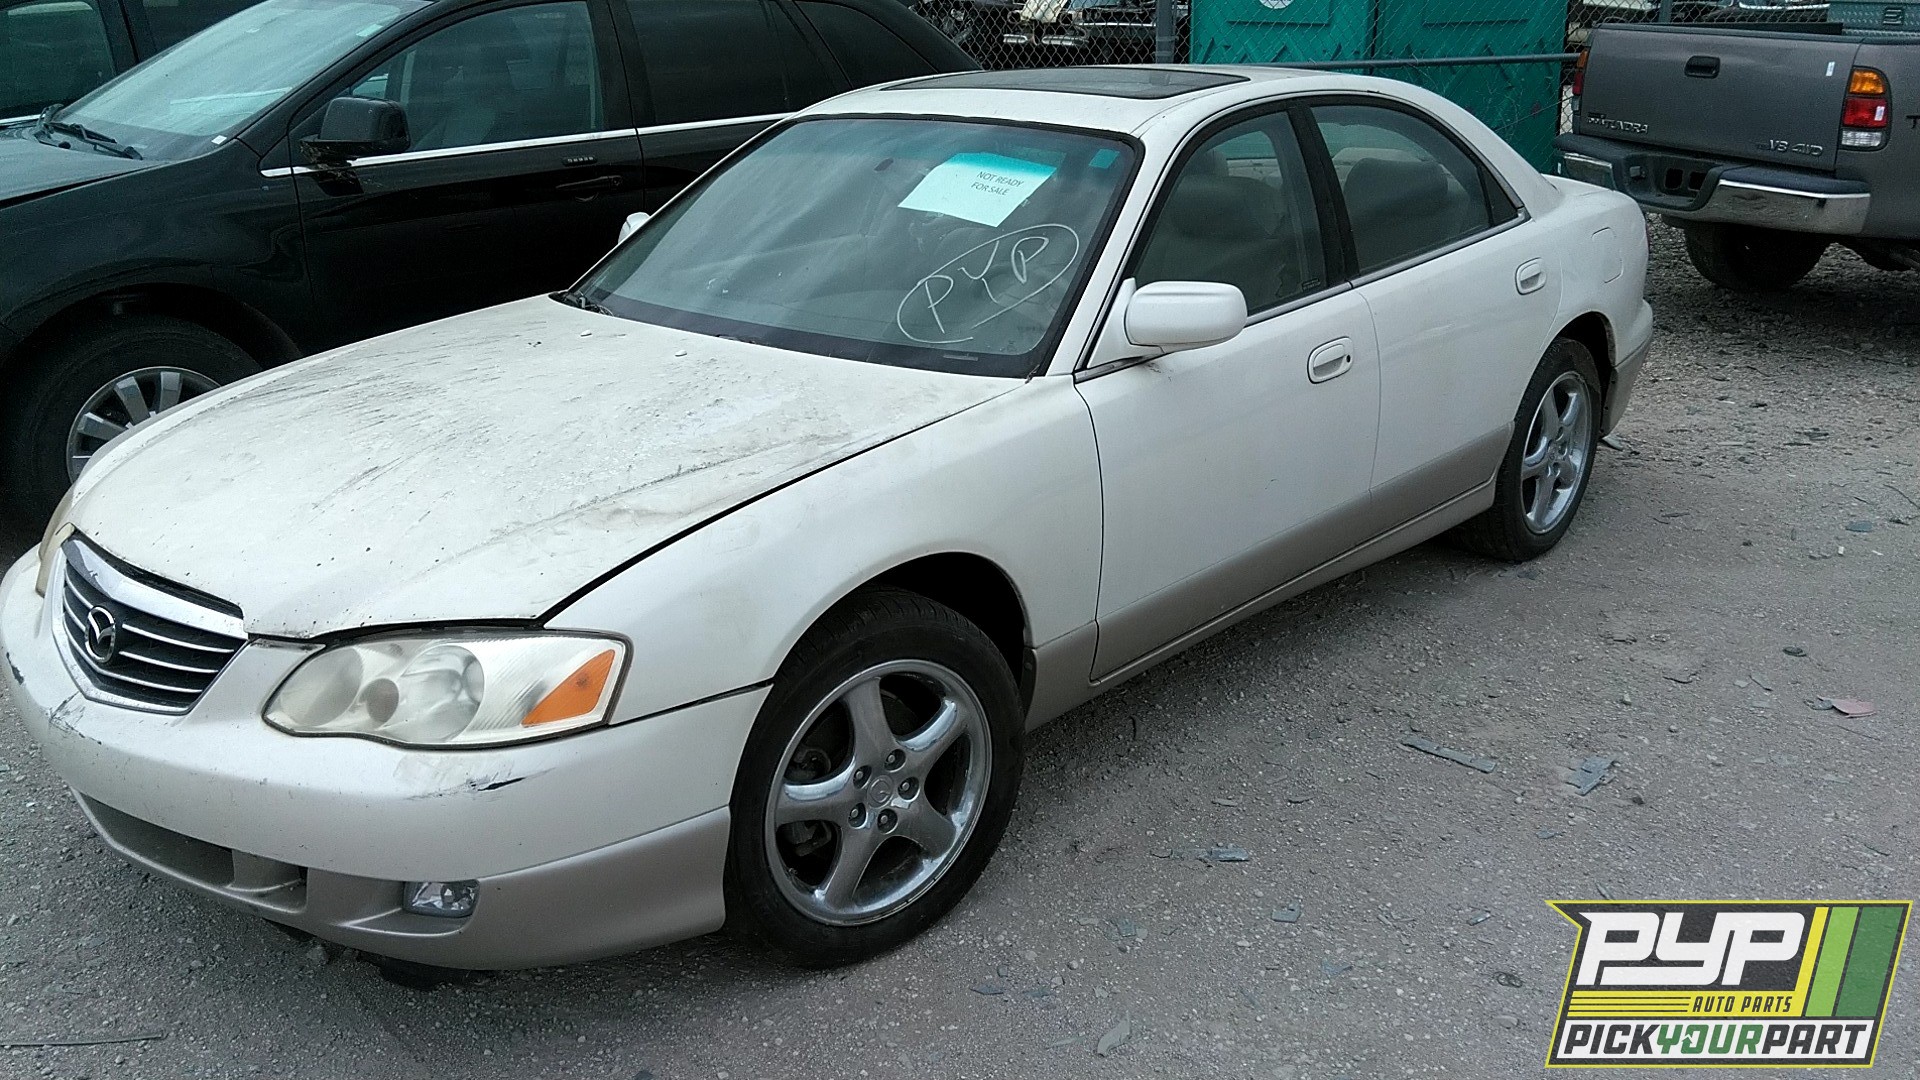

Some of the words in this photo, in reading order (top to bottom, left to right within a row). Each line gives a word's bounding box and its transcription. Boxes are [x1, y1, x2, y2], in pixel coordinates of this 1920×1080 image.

[1603, 118, 1649, 134] TUNDRA
[1769, 139, 1789, 152] V8
[976, 171, 998, 181] NOT
[994, 176, 1025, 188] READY
[970, 181, 990, 191] FOR
[988, 186, 1010, 196] SALE
[925, 236, 1050, 334] PYP
